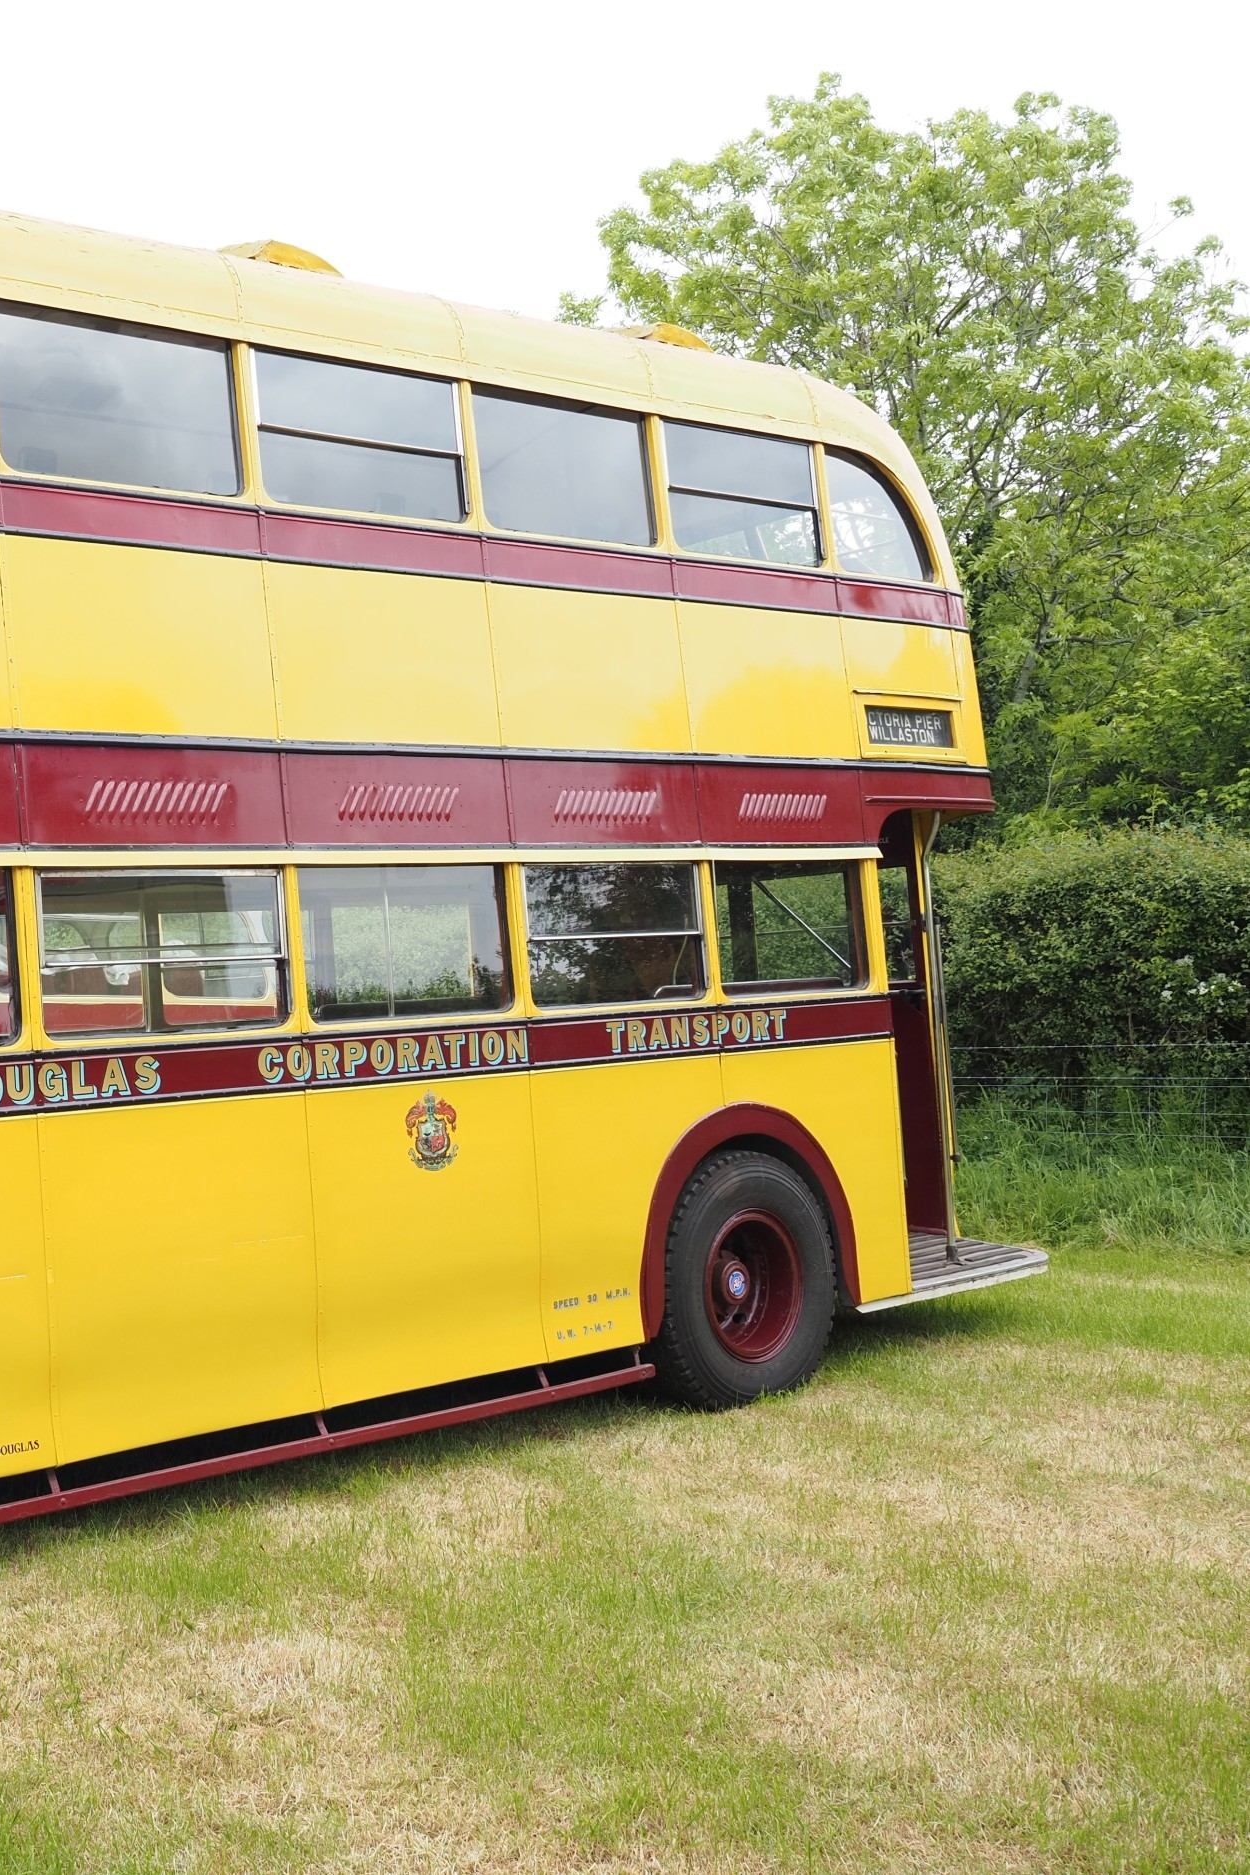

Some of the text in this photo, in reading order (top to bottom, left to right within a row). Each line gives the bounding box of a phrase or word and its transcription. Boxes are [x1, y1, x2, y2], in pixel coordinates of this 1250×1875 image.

[915, 715, 942, 730] PIER
[868, 725, 935, 744] WILLASTON
[258, 1028, 528, 1084] CORPORATION
[606, 1009, 786, 1053] TRANSPORT
[553, 1287, 631, 1310] SPEED 30 M.P.H.
